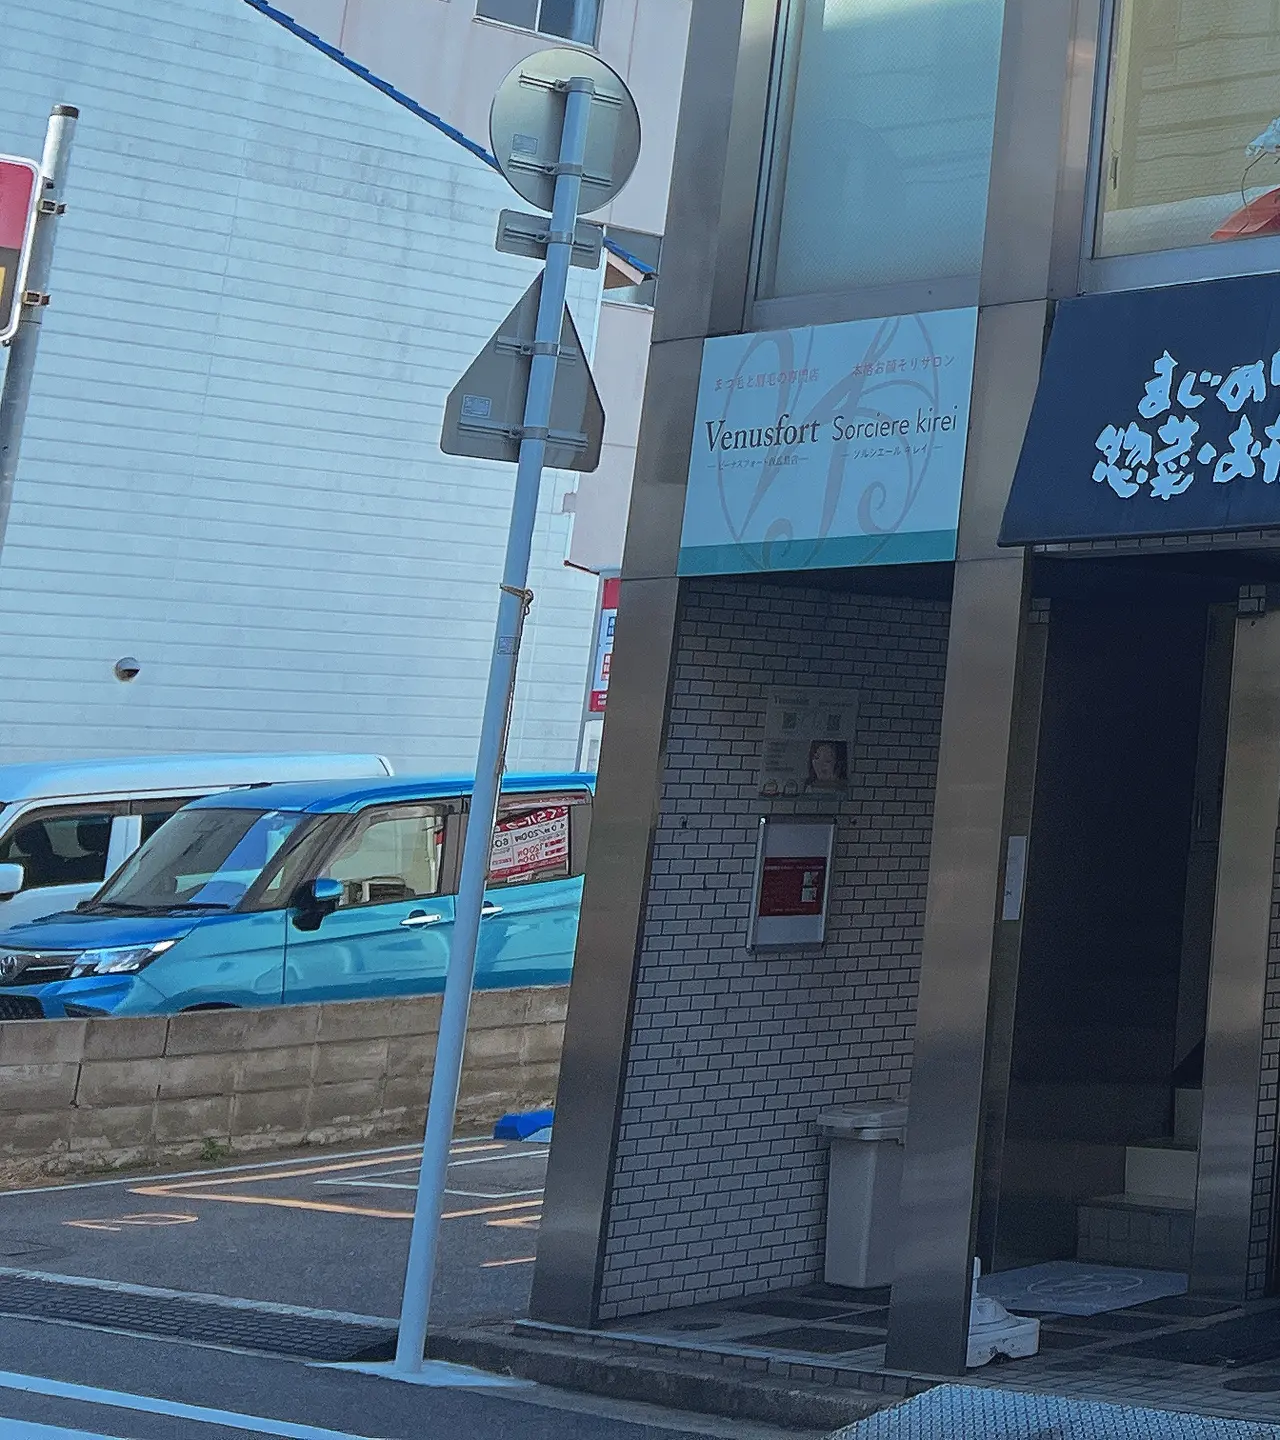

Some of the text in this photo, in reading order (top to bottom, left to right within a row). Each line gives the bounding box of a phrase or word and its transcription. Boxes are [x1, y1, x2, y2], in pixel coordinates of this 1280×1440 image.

[705, 405, 959, 453] Venusfort Sorciere kirei
